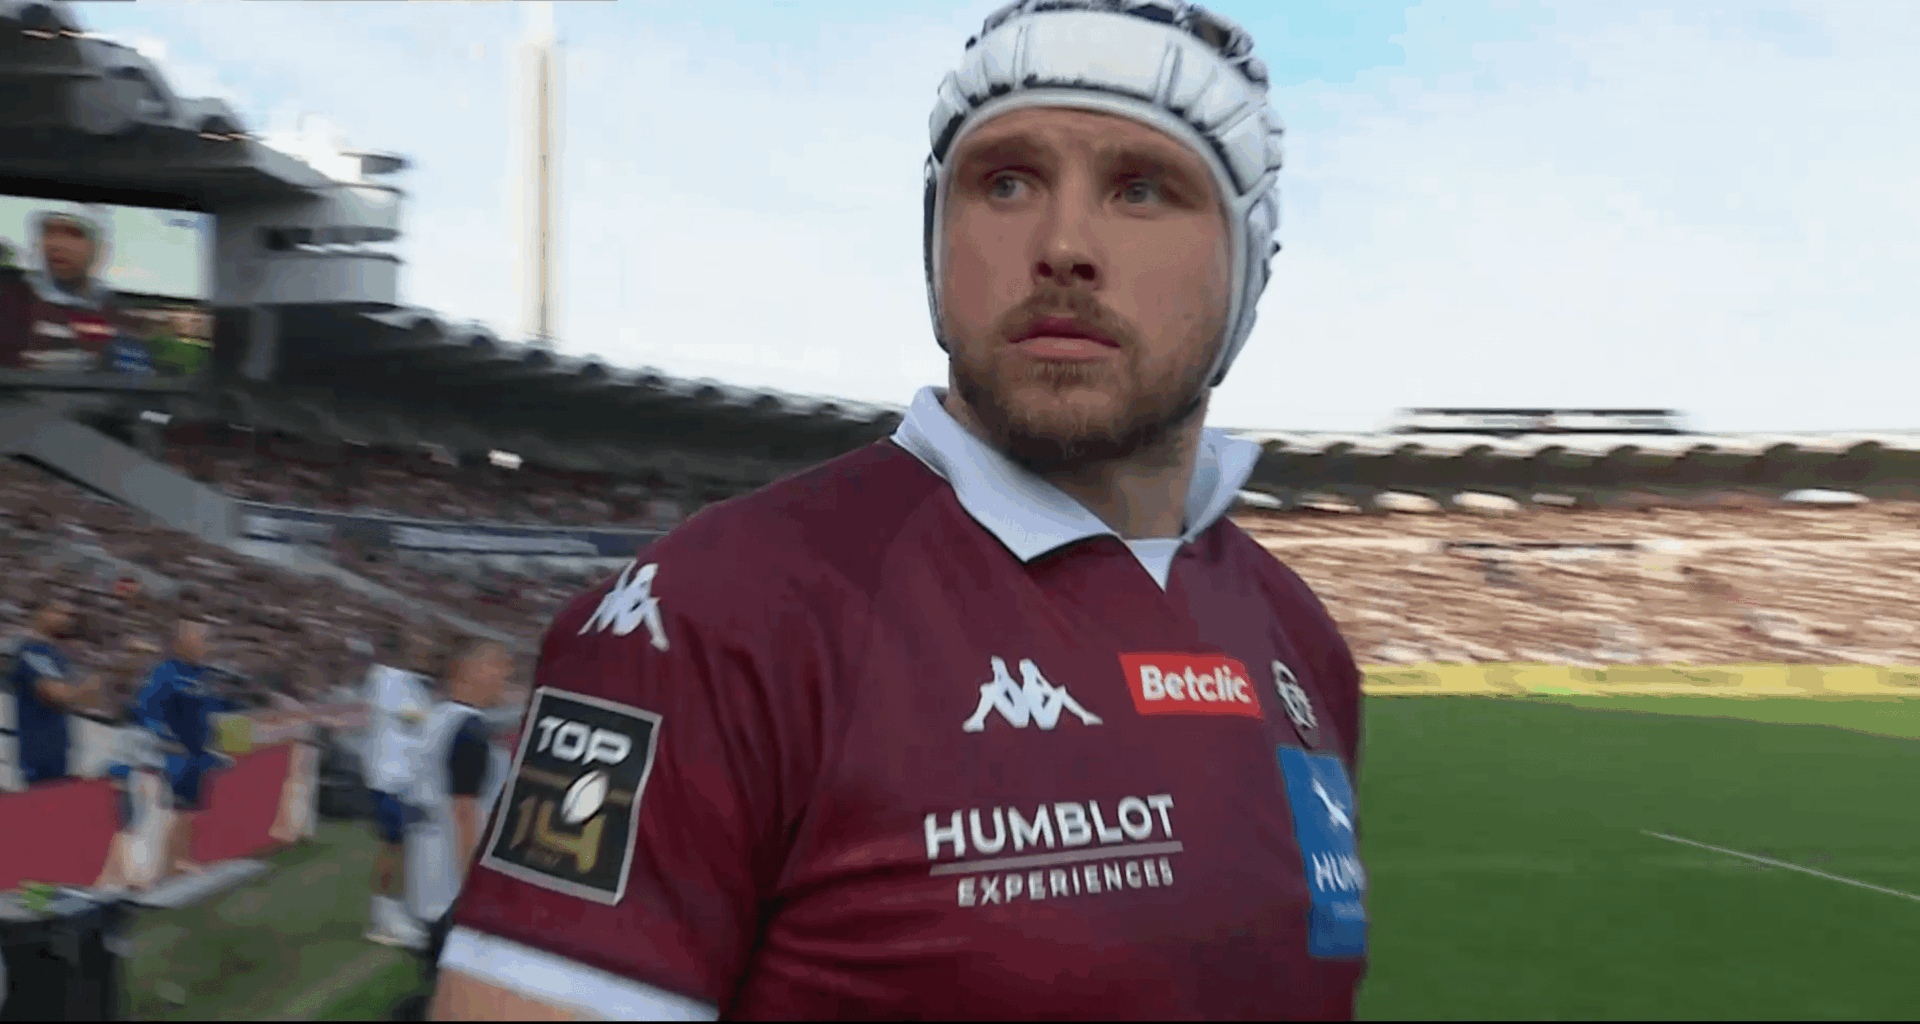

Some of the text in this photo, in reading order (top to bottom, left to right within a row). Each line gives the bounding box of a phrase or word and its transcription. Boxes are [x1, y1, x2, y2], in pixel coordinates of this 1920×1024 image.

[1140, 664, 1251, 704] Betclic
[536, 715, 633, 766] TOP
[509, 796, 606, 874] 14
[924, 794, 1174, 860] HUMBLOT
[958, 857, 1174, 907] EXPERIENCES
